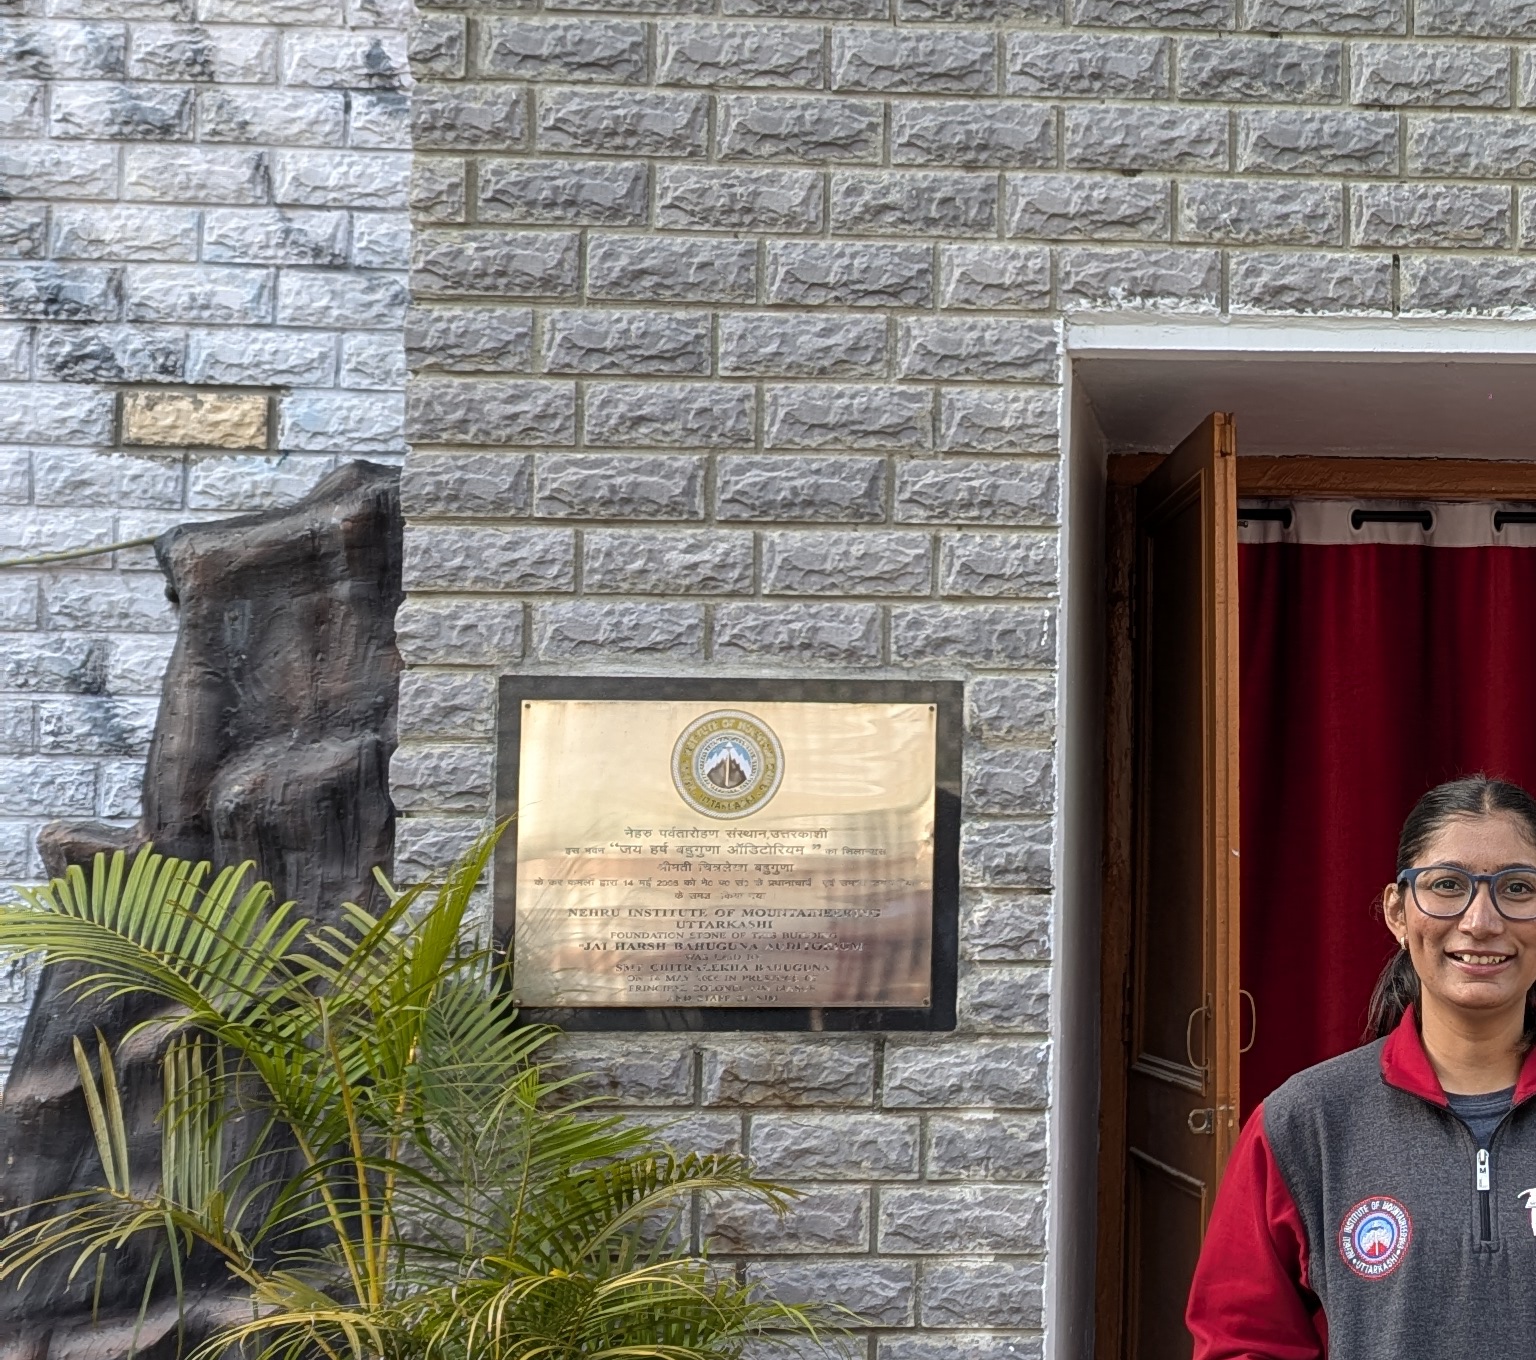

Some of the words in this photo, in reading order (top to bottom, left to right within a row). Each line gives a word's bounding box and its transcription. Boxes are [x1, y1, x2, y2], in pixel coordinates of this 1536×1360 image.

[568, 909, 620, 917] NEHRU
[628, 909, 707, 917] INSTITUTE
[715, 909, 735, 917] OF
[676, 920, 773, 929] UTTARKASHI
[1356, 1254, 1399, 1274] UTTARKASHI
